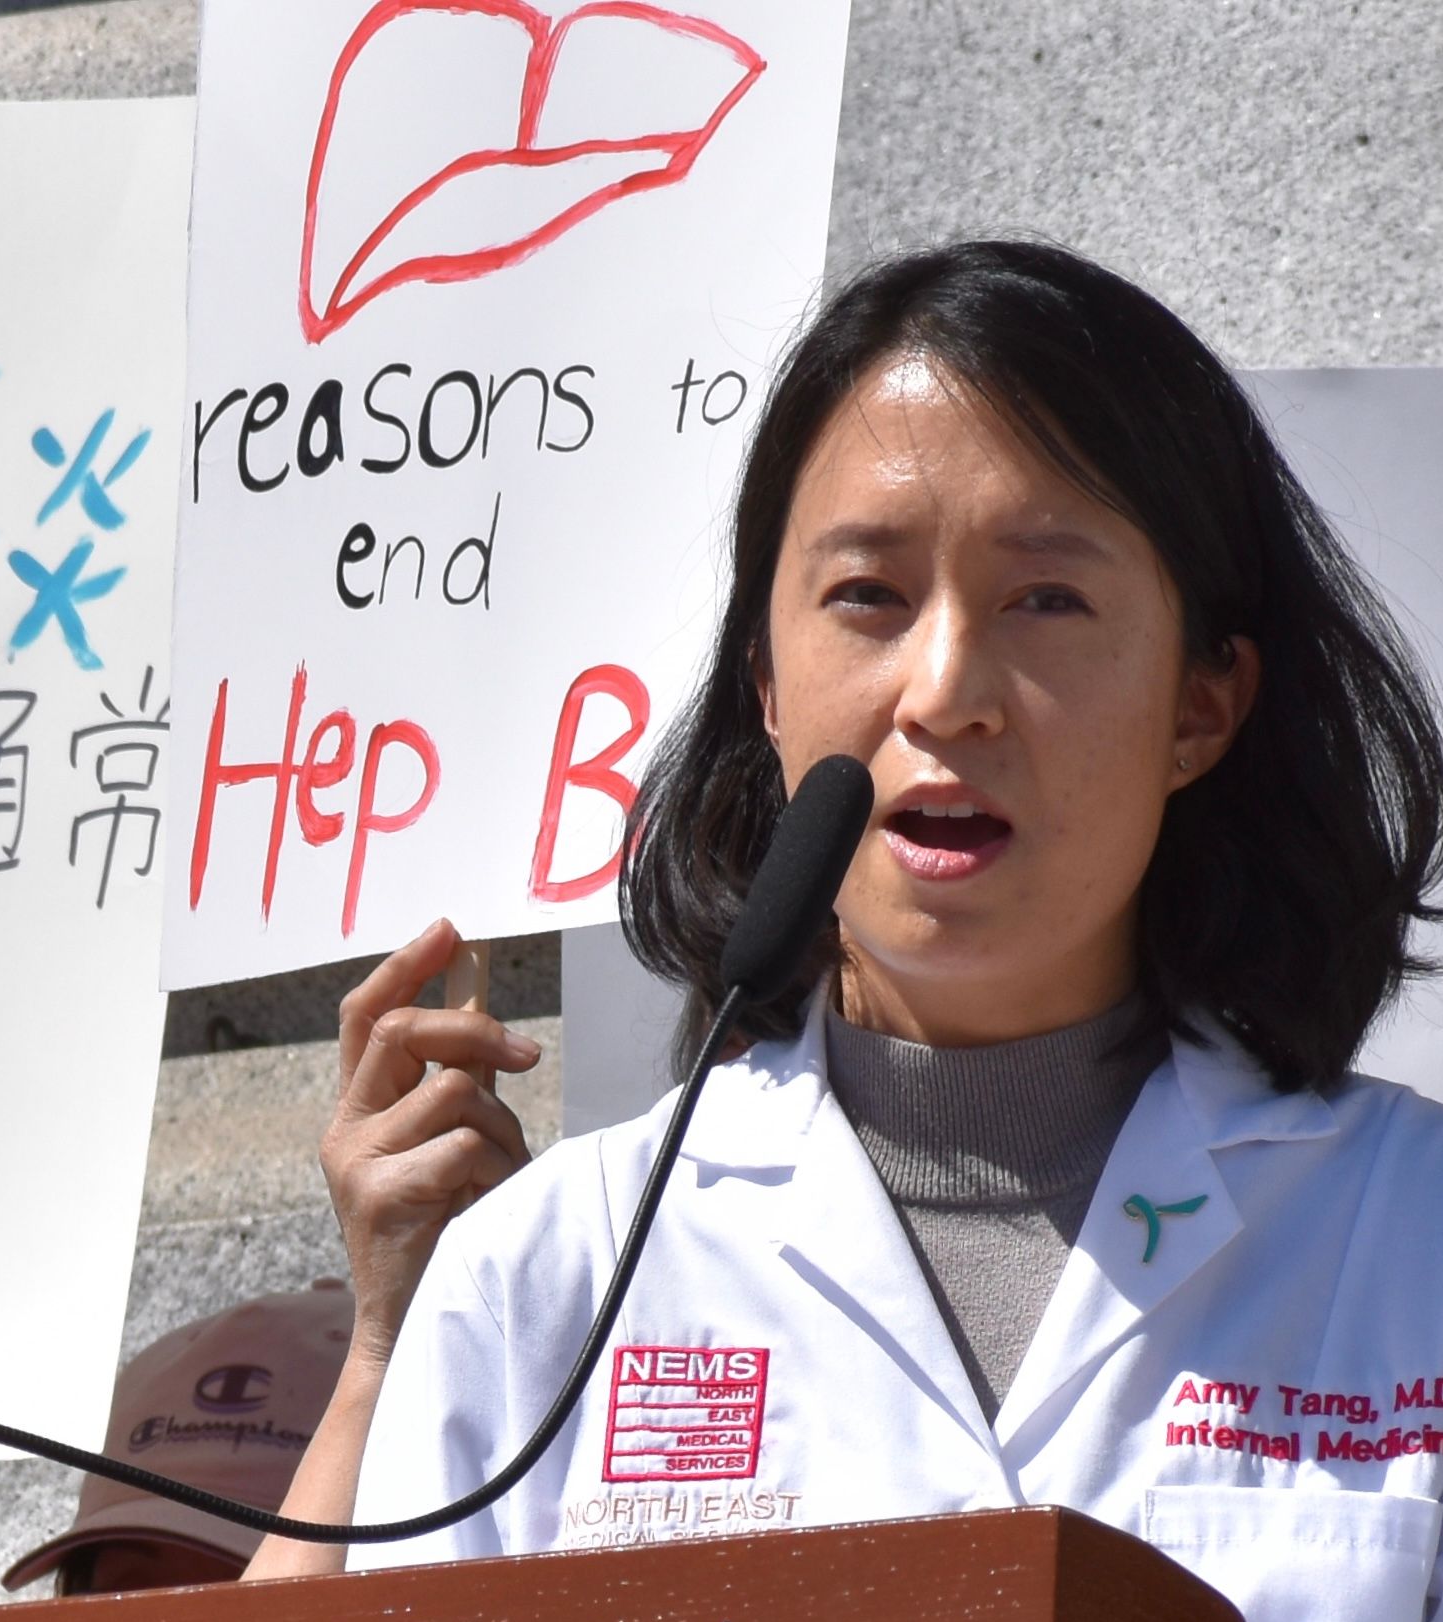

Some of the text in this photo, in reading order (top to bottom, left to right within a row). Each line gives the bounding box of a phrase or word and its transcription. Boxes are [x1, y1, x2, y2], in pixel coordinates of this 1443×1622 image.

[191, 358, 748, 504] reasons to
[336, 491, 502, 610] end
[189, 658, 652, 942] Hep B
[620, 1351, 758, 1382] NEMS
[697, 1385, 754, 1400] NORTH
[1173, 1378, 1260, 1415] Amy
[1278, 1384, 1380, 1425] Tang,
[707, 1409, 754, 1423] EAST
[676, 1433, 749, 1447] MEDICAL
[1165, 1421, 1300, 1462] Internal
[665, 1456, 746, 1471] SERVICES
[565, 1492, 803, 1532] NORTH EAST
